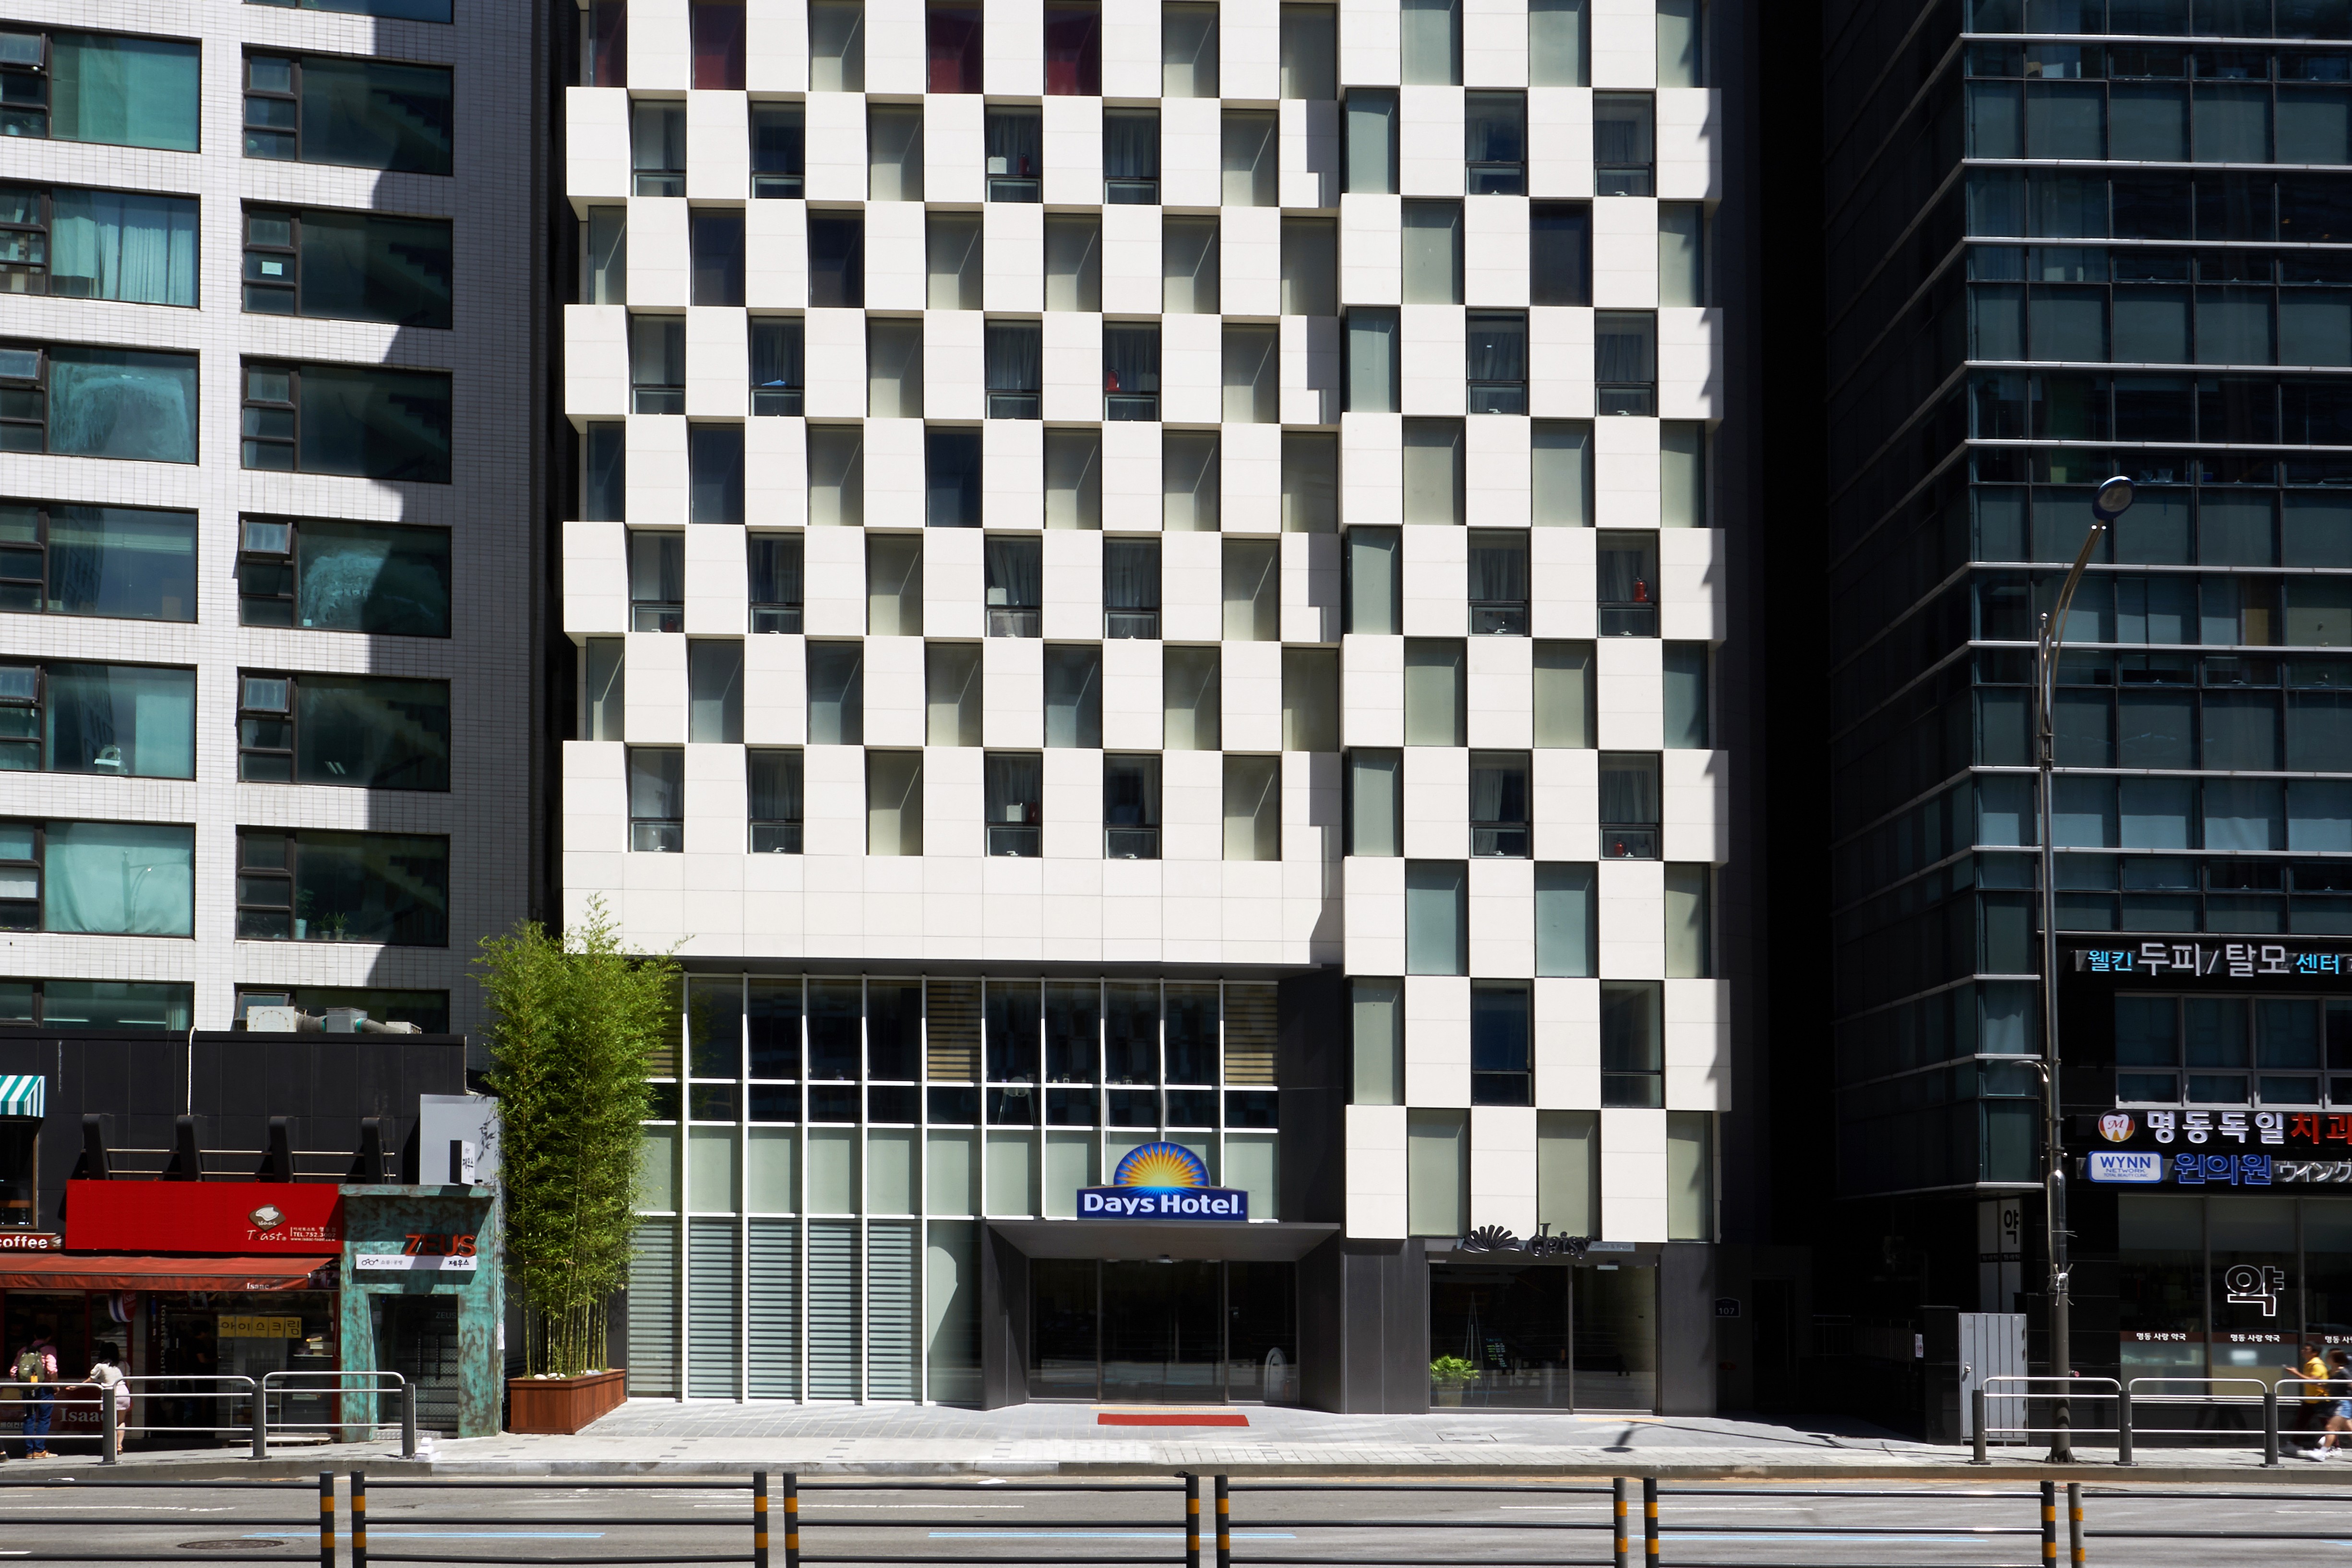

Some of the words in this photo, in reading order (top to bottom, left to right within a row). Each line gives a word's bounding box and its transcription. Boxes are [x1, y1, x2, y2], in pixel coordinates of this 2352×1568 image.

[2088, 950, 2132, 971] 웰킨
[2137, 942, 2290, 977] 두피/탈모
[2296, 954, 2339, 974] 센터
[2107, 1119, 2124, 1129] M
[2100, 1156, 2151, 1168] WYNN
[1084, 1193, 1155, 1215] Days
[1161, 1194, 1239, 1214] Hotel
[2004, 1209, 2019, 1244] 약
[0, 1236, 48, 1248] offee
[405, 1234, 477, 1257] ZEUS
[2225, 1264, 2284, 1317] 약
[221, 1321, 299, 1335] 아이스크림
[2136, 1332, 2151, 1341] 명동
[2153, 1333, 2169, 1341] 사랑
[2171, 1333, 2186, 1341] 약국
[2230, 1334, 2245, 1342] 명동
[2247, 1334, 2263, 1342] 사랑
[2265, 1334, 2280, 1342] 약국
[60, 1408, 103, 1422] Isaa
